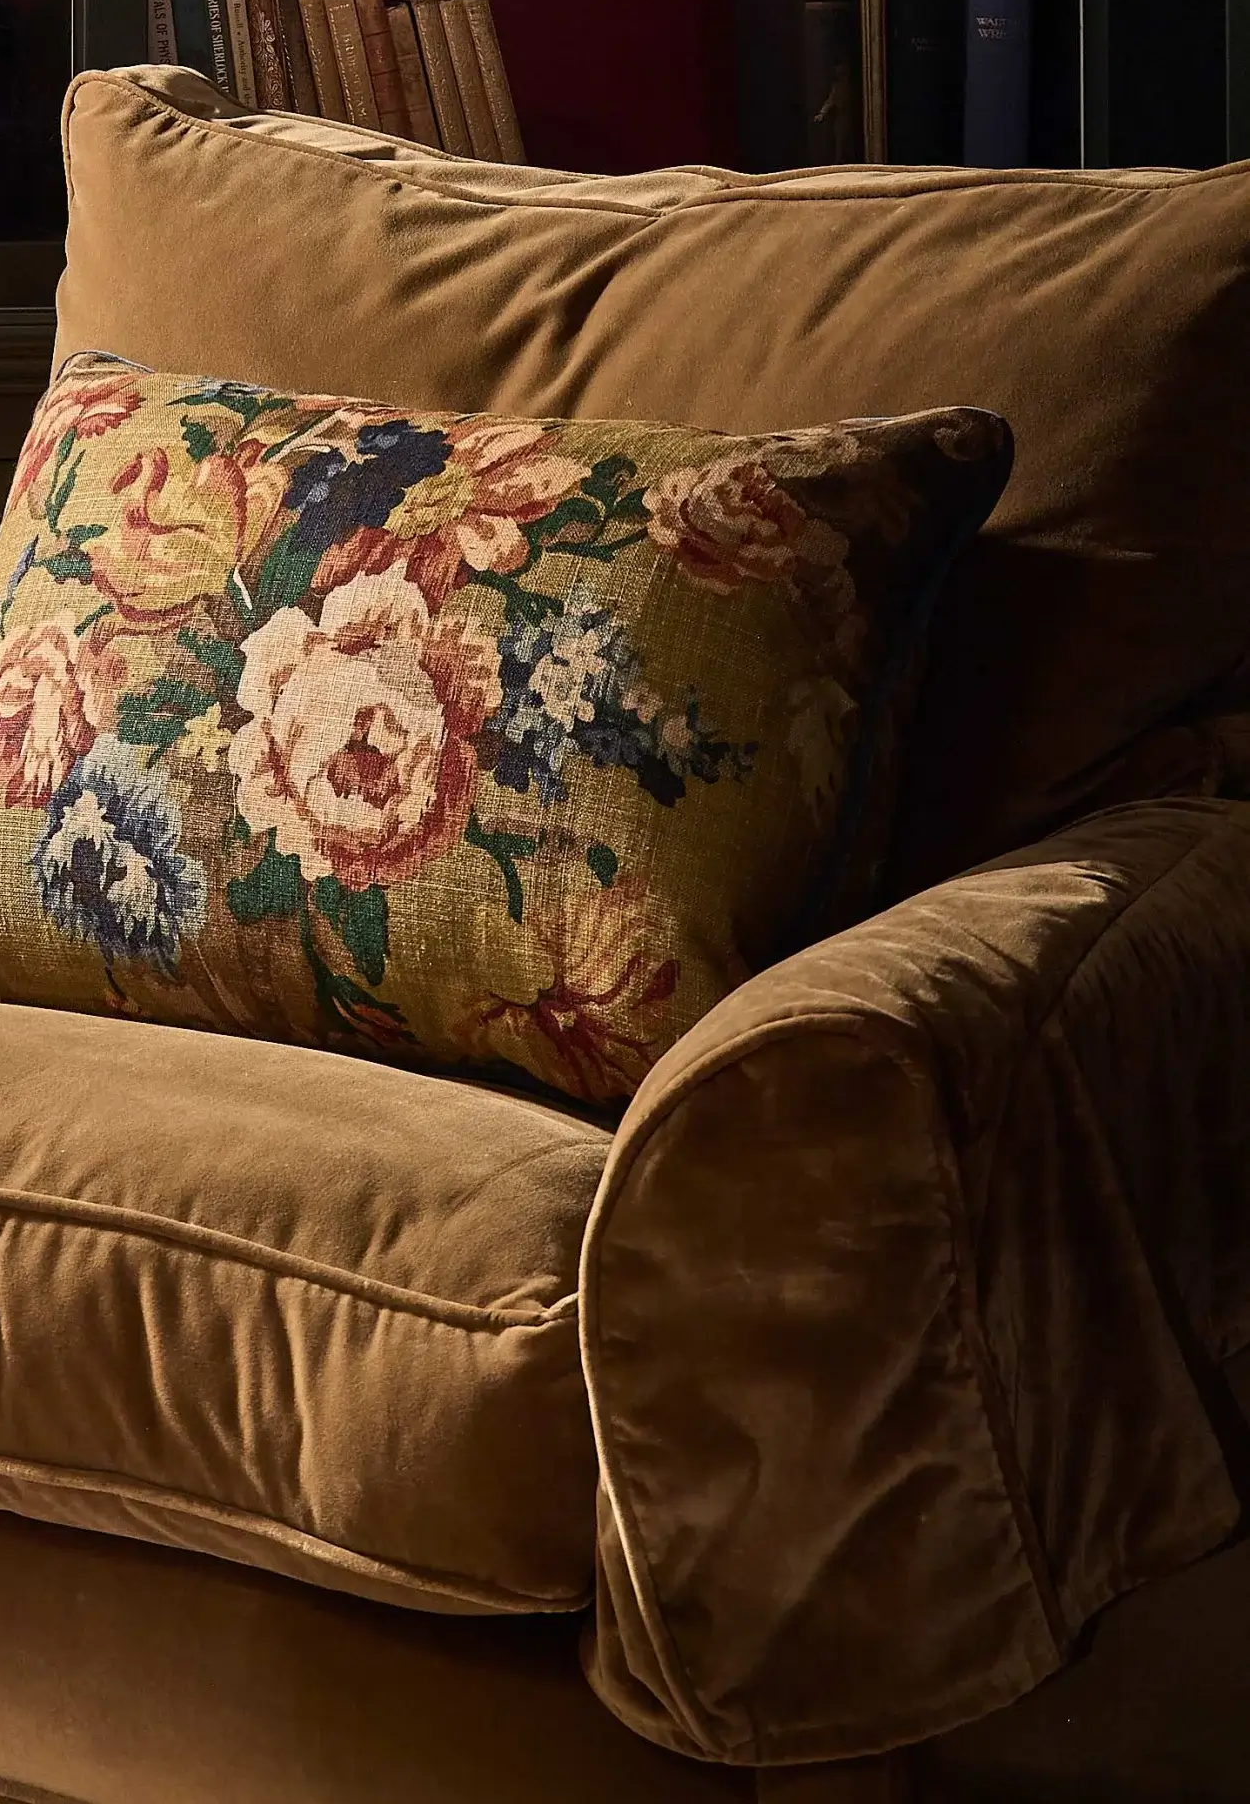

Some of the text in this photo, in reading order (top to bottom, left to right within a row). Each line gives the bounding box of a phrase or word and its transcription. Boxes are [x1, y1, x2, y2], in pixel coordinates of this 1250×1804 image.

[156, 24, 168, 40] OF
[209, 18, 222, 33] OF
[211, 33, 229, 86] SHERLOCK
